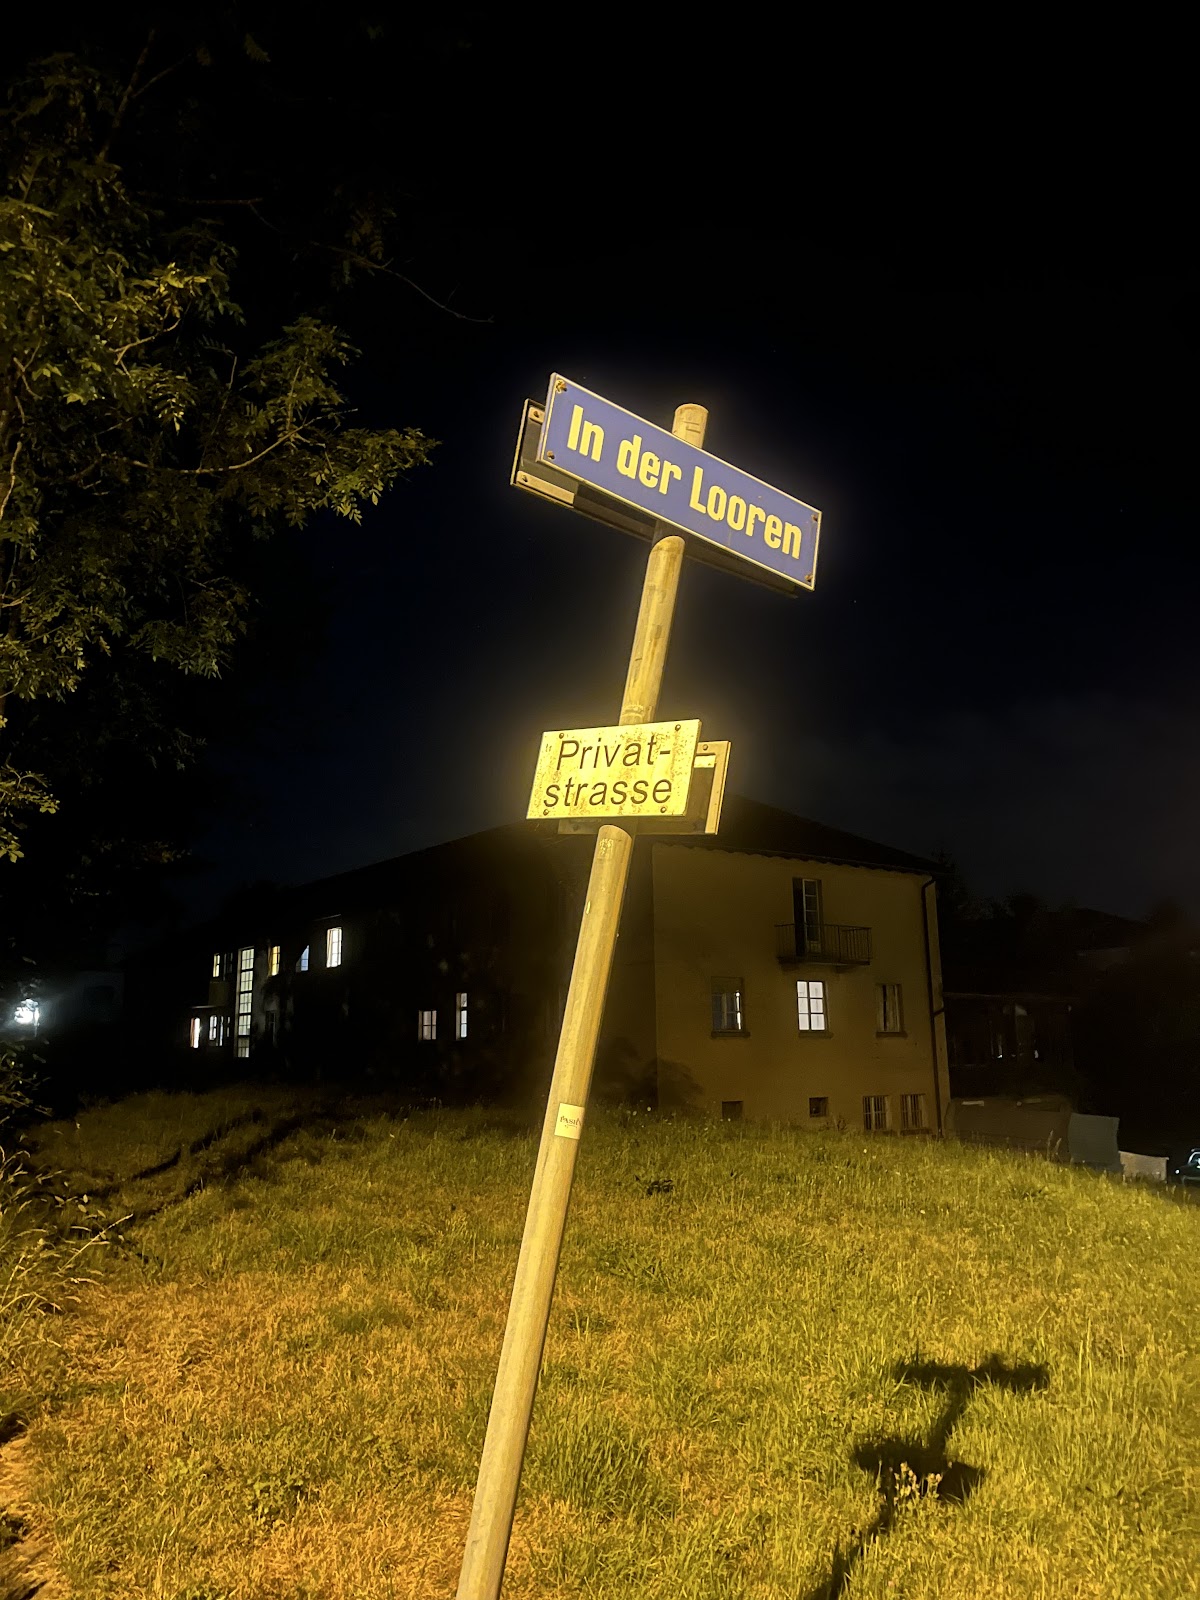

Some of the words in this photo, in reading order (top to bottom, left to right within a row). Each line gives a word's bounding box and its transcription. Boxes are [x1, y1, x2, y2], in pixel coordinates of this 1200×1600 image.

[567, 404, 604, 462] In
[616, 434, 682, 495] der
[689, 466, 802, 559] Looren
[556, 735, 671, 771] Privat-
[543, 776, 672, 808] strasse
